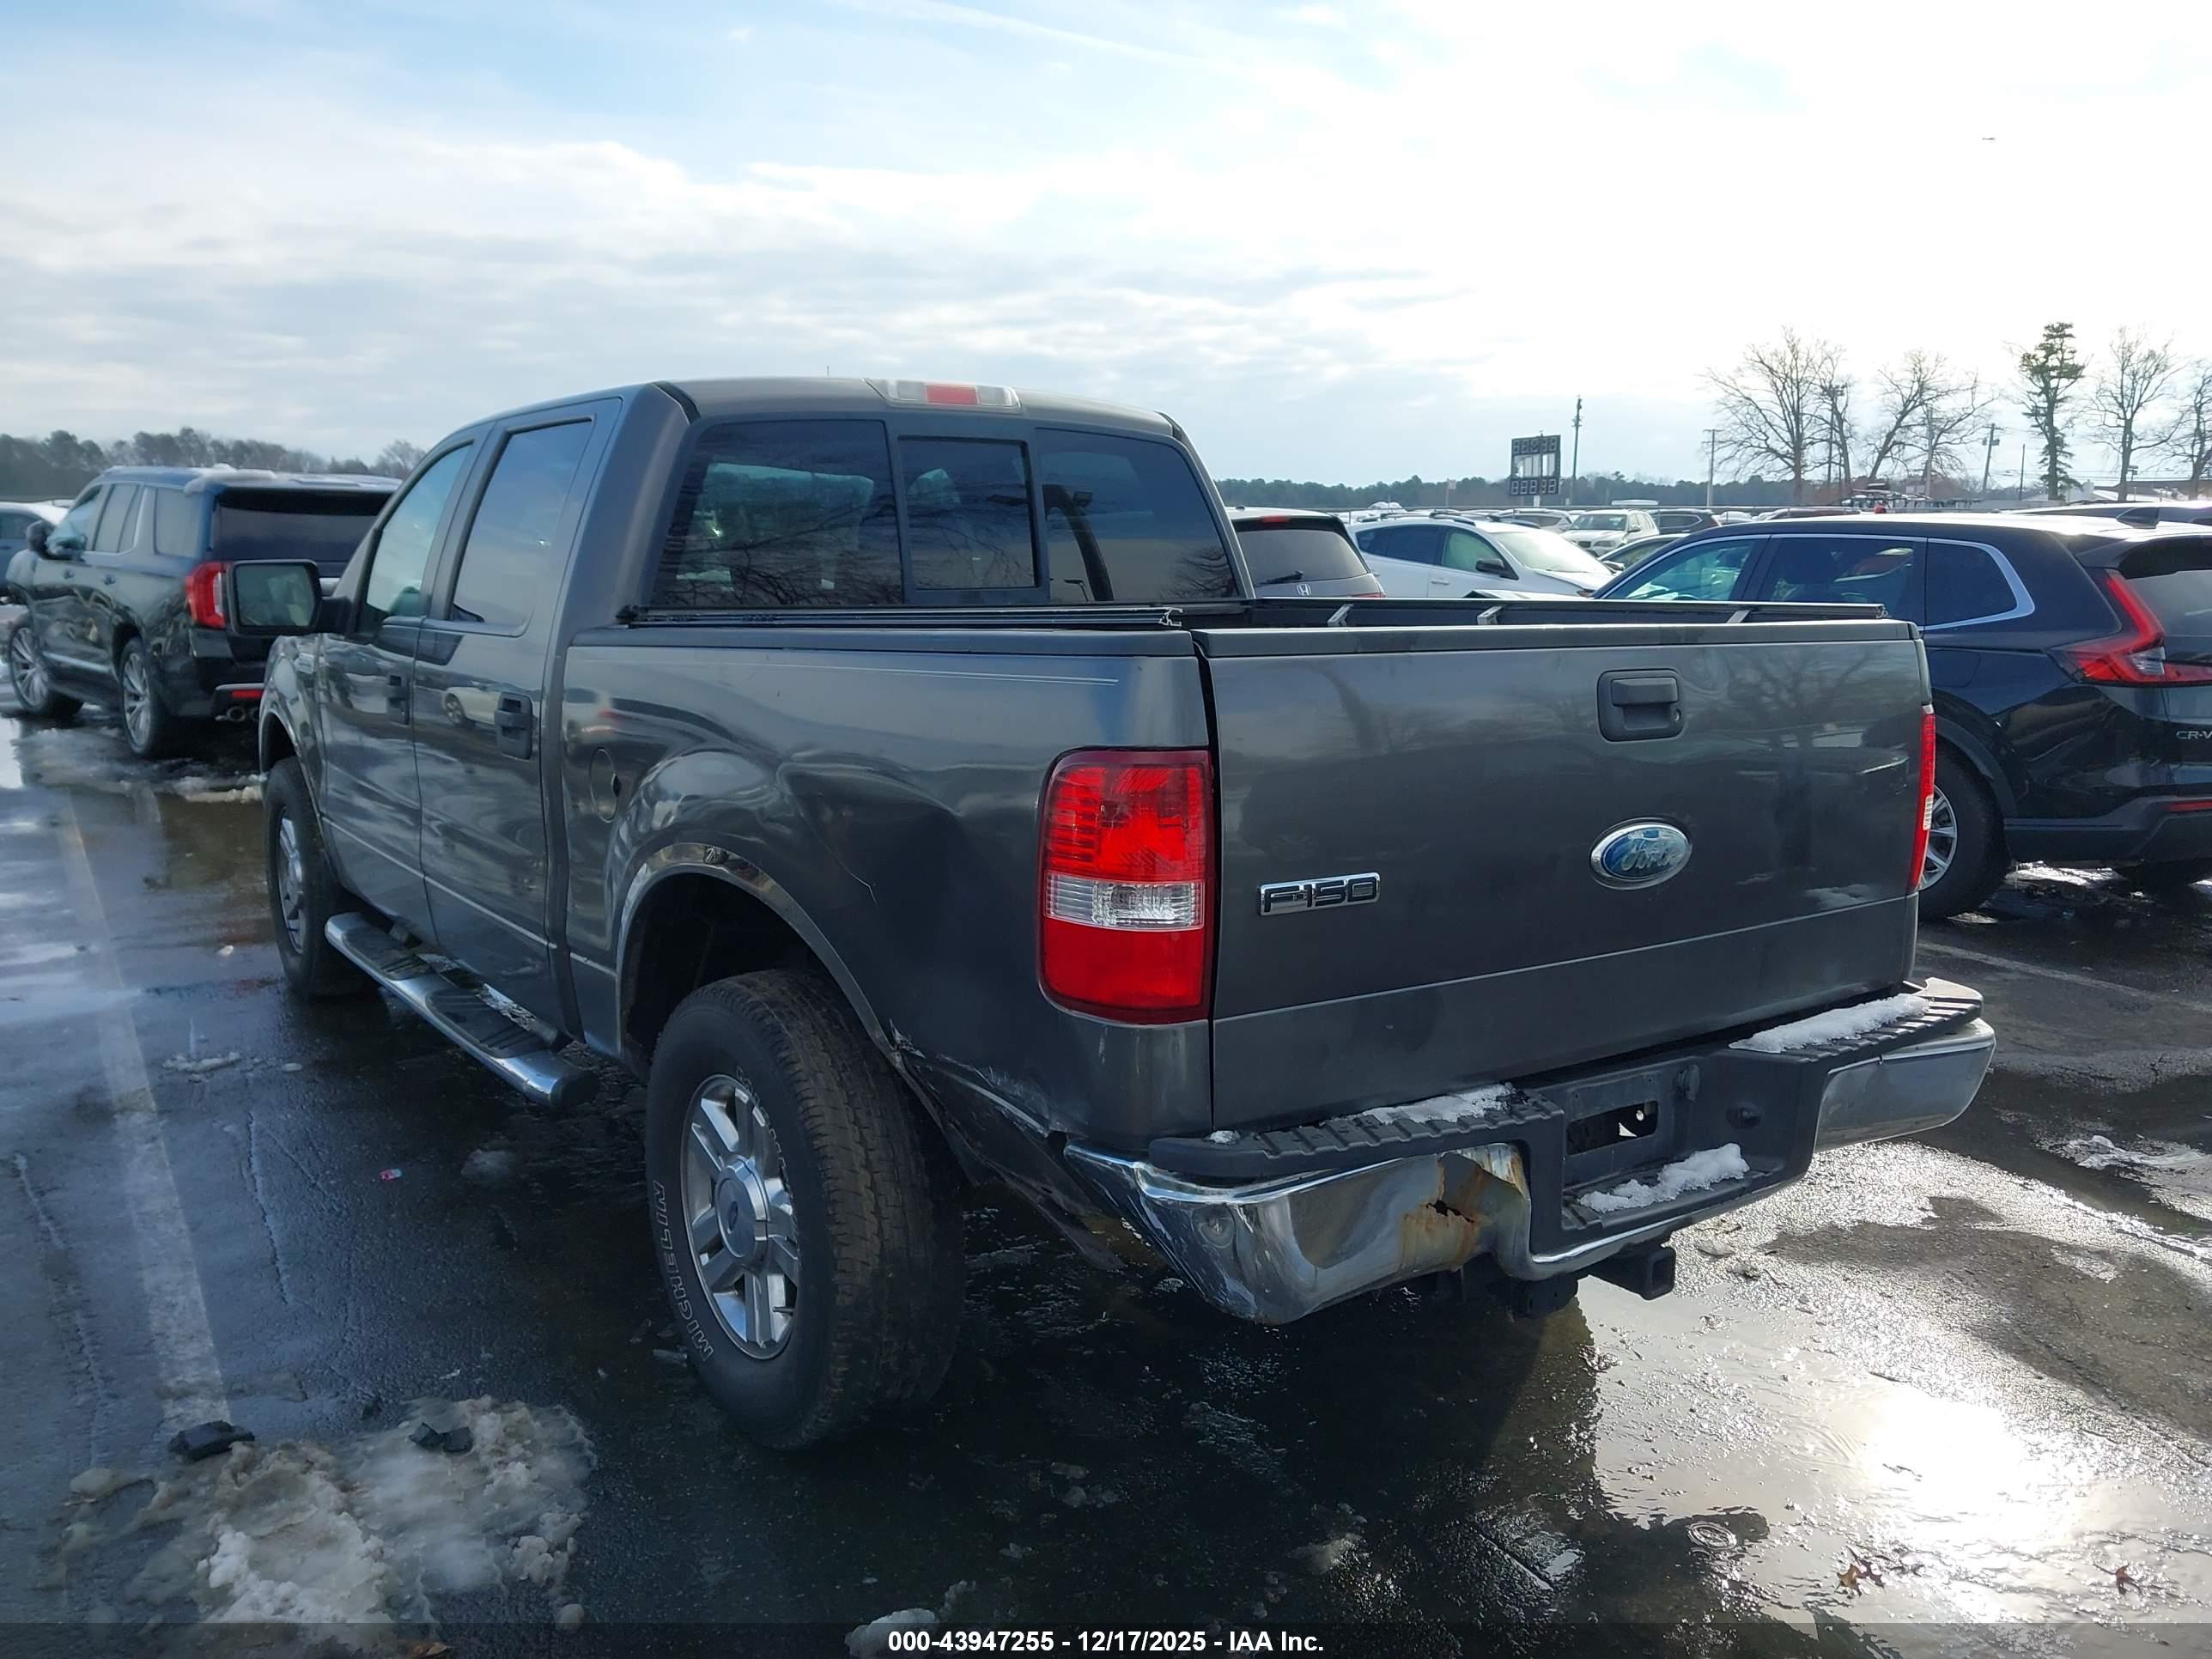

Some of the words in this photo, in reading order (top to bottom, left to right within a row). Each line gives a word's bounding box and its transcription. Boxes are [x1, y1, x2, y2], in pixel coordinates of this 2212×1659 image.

[1619, 836, 1684, 872] Ford
[1261, 873, 1379, 914] F-150
[652, 1179, 715, 1363] MICHELIN
